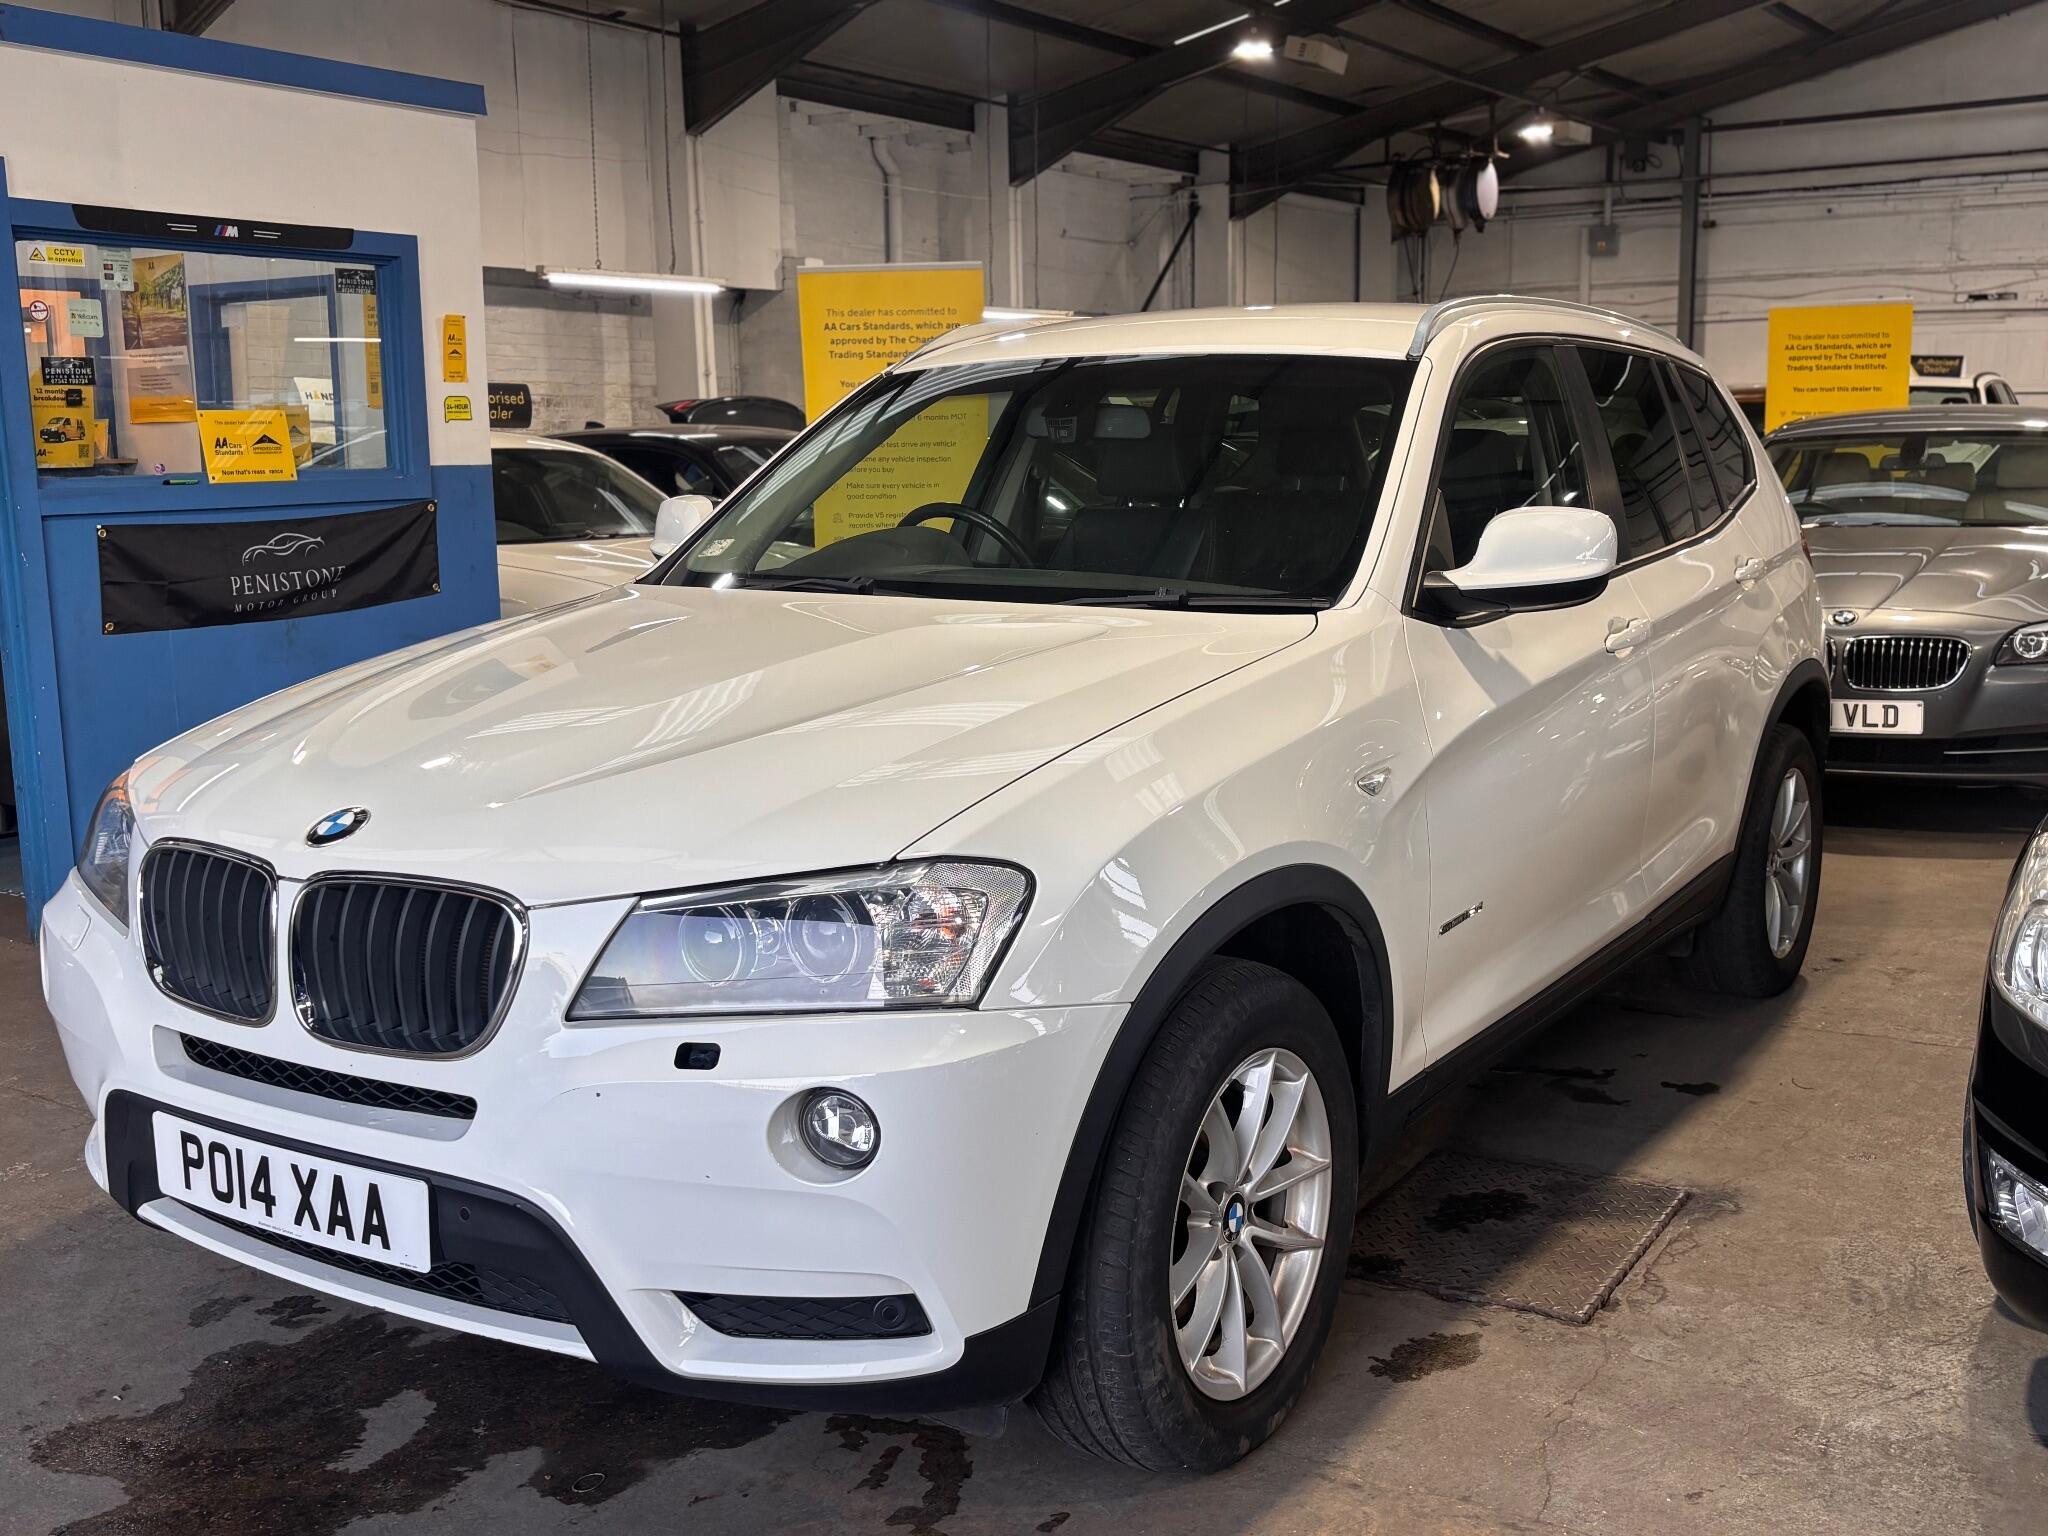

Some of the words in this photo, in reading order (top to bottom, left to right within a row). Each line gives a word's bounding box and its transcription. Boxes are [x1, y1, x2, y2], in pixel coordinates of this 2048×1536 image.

[54, 248, 76, 257] CCTV
[826, 308, 845, 317] This
[847, 309, 876, 317] dealer
[878, 308, 894, 316] has
[896, 308, 945, 316] committed
[824, 323, 837, 331] AA
[839, 323, 860, 331] Cars
[863, 322, 914, 331] Standards,
[916, 322, 943, 330] which
[830, 336, 874, 346] approved
[876, 336, 887, 346] by
[890, 336, 907, 344] The
[829, 350, 864, 360] Trading
[488, 392, 524, 404] orised
[490, 408, 513, 419] aler
[215, 437, 228, 448] AA
[916, 456, 951, 464] inspection
[230, 566, 346, 596] PENISTONE
[234, 600, 284, 613] MOTOR
[293, 589, 337, 604] GROUP
[1843, 703, 1899, 728] VLD
[180, 1130, 276, 1218] PO14
[290, 1163, 391, 1250] XAA
